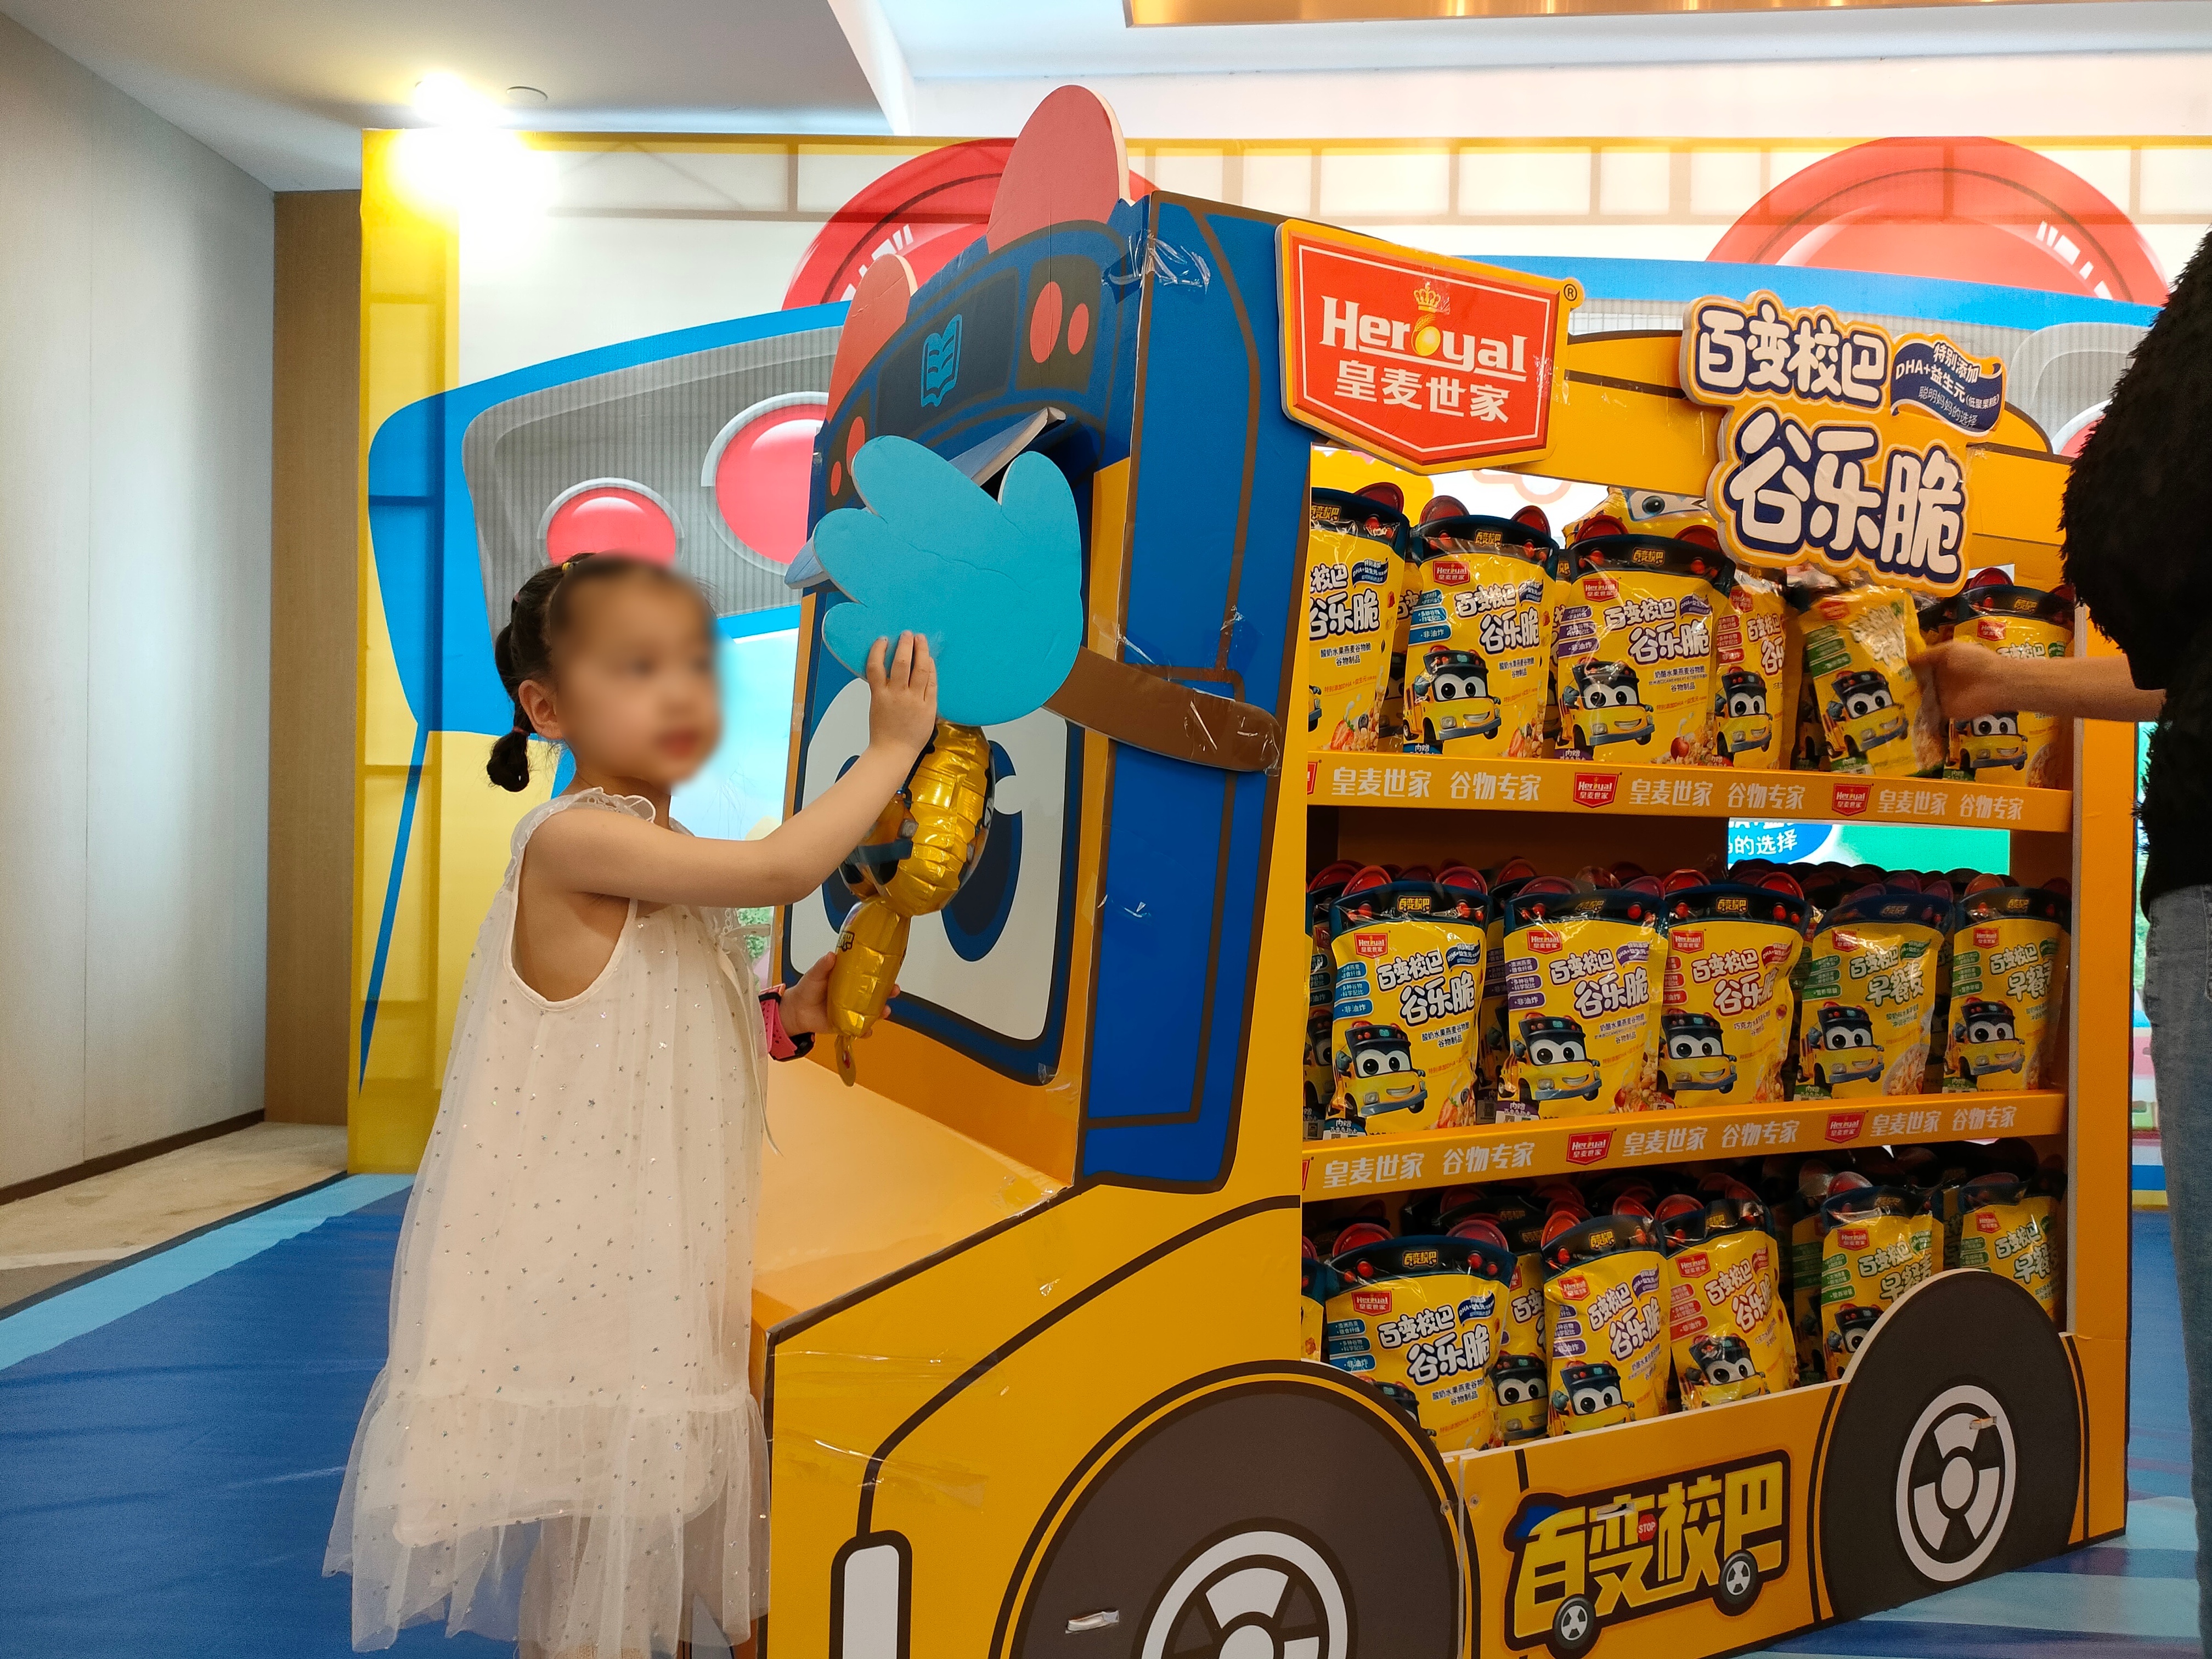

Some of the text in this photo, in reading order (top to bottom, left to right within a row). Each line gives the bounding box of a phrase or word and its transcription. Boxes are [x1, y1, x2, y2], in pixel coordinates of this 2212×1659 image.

[1319, 295, 1528, 374] Heroyal
[1700, 299, 1886, 402] 百变校巴
[1933, 342, 1980, 384] 特别添加
[1334, 359, 1510, 424] 皇麦世家
[1918, 386, 1978, 428] 聪明妈妈的选择
[1728, 411, 1963, 576] 谷乐脆
[1310, 564, 1348, 592] 校巴
[1310, 589, 1379, 638] 谷乐脆
[1455, 584, 1516, 617] 百变校巴
[1605, 599, 1676, 630] 百变校巴
[1481, 607, 1540, 652] 谷乐脆
[1630, 619, 1709, 662] 谷乐脆
[1747, 614, 1781, 641] 百变校巴
[1336, 655, 1361, 667] 谷物制品
[1761, 636, 1784, 674] 谷乐
[1671, 682, 1696, 692] 谷物制品
[1331, 767, 1432, 799] 皇麦世家
[1450, 771, 1542, 801] 谷物专家
[1578, 781, 1612, 792] Heroyal
[1579, 791, 1609, 800] 皇麦世家
[1629, 778, 1713, 807] 皇麦世家
[1728, 783, 1806, 810] 谷物专家
[1878, 789, 1948, 816] 皇麦世家
[1959, 793, 2024, 821] 谷物专家
[1398, 898, 1431, 911] 百变校巴
[1718, 899, 1747, 912] 百变校巴
[1376, 951, 1443, 990] 百变校巴
[1550, 949, 1614, 984] 百变校巴
[1692, 949, 1758, 982] 百变校巴
[1850, 946, 1899, 979] 百变校巴
[1990, 943, 2038, 975] 百变校巴
[1344, 1005, 1366, 1013] 非油炸
[1401, 971, 1475, 1024] 谷乐脆
[1517, 996, 1539, 1005] 非油炸
[1575, 968, 1648, 1017] 谷乐脆
[1438, 1035, 1463, 1048] 谷物制品
[1721, 1120, 1800, 1148] 谷物专家
[1870, 1110, 1942, 1137] 皇麦世家
[1952, 1105, 2017, 1131] 谷物专家
[1443, 1141, 1535, 1176] 谷物专家
[1622, 1126, 1708, 1158] 皇麦世家
[1323, 1152, 1425, 1189] 皇麦世家
[1404, 1251, 1437, 1266] 百变校巴
[1858, 1241, 1913, 1277] 百变校巴
[2013, 1243, 2051, 1284] 早餐
[1704, 1259, 1753, 1306] 百变校巴
[1513, 1289, 1544, 1323] 百变
[1588, 1283, 1633, 1330] 百变校巴
[1378, 1306, 1454, 1347] 百变校巴
[1609, 1297, 1661, 1359] 谷乐脆
[1408, 1325, 1491, 1383] 谷乐脆
[1432, 1378, 1485, 1401] 酸奶水果燕麦谷物
[1450, 1391, 1478, 1406] 谷物制品
[1638, 1521, 1656, 1534] STOP
[1514, 1461, 1784, 1639] 百变校巴
